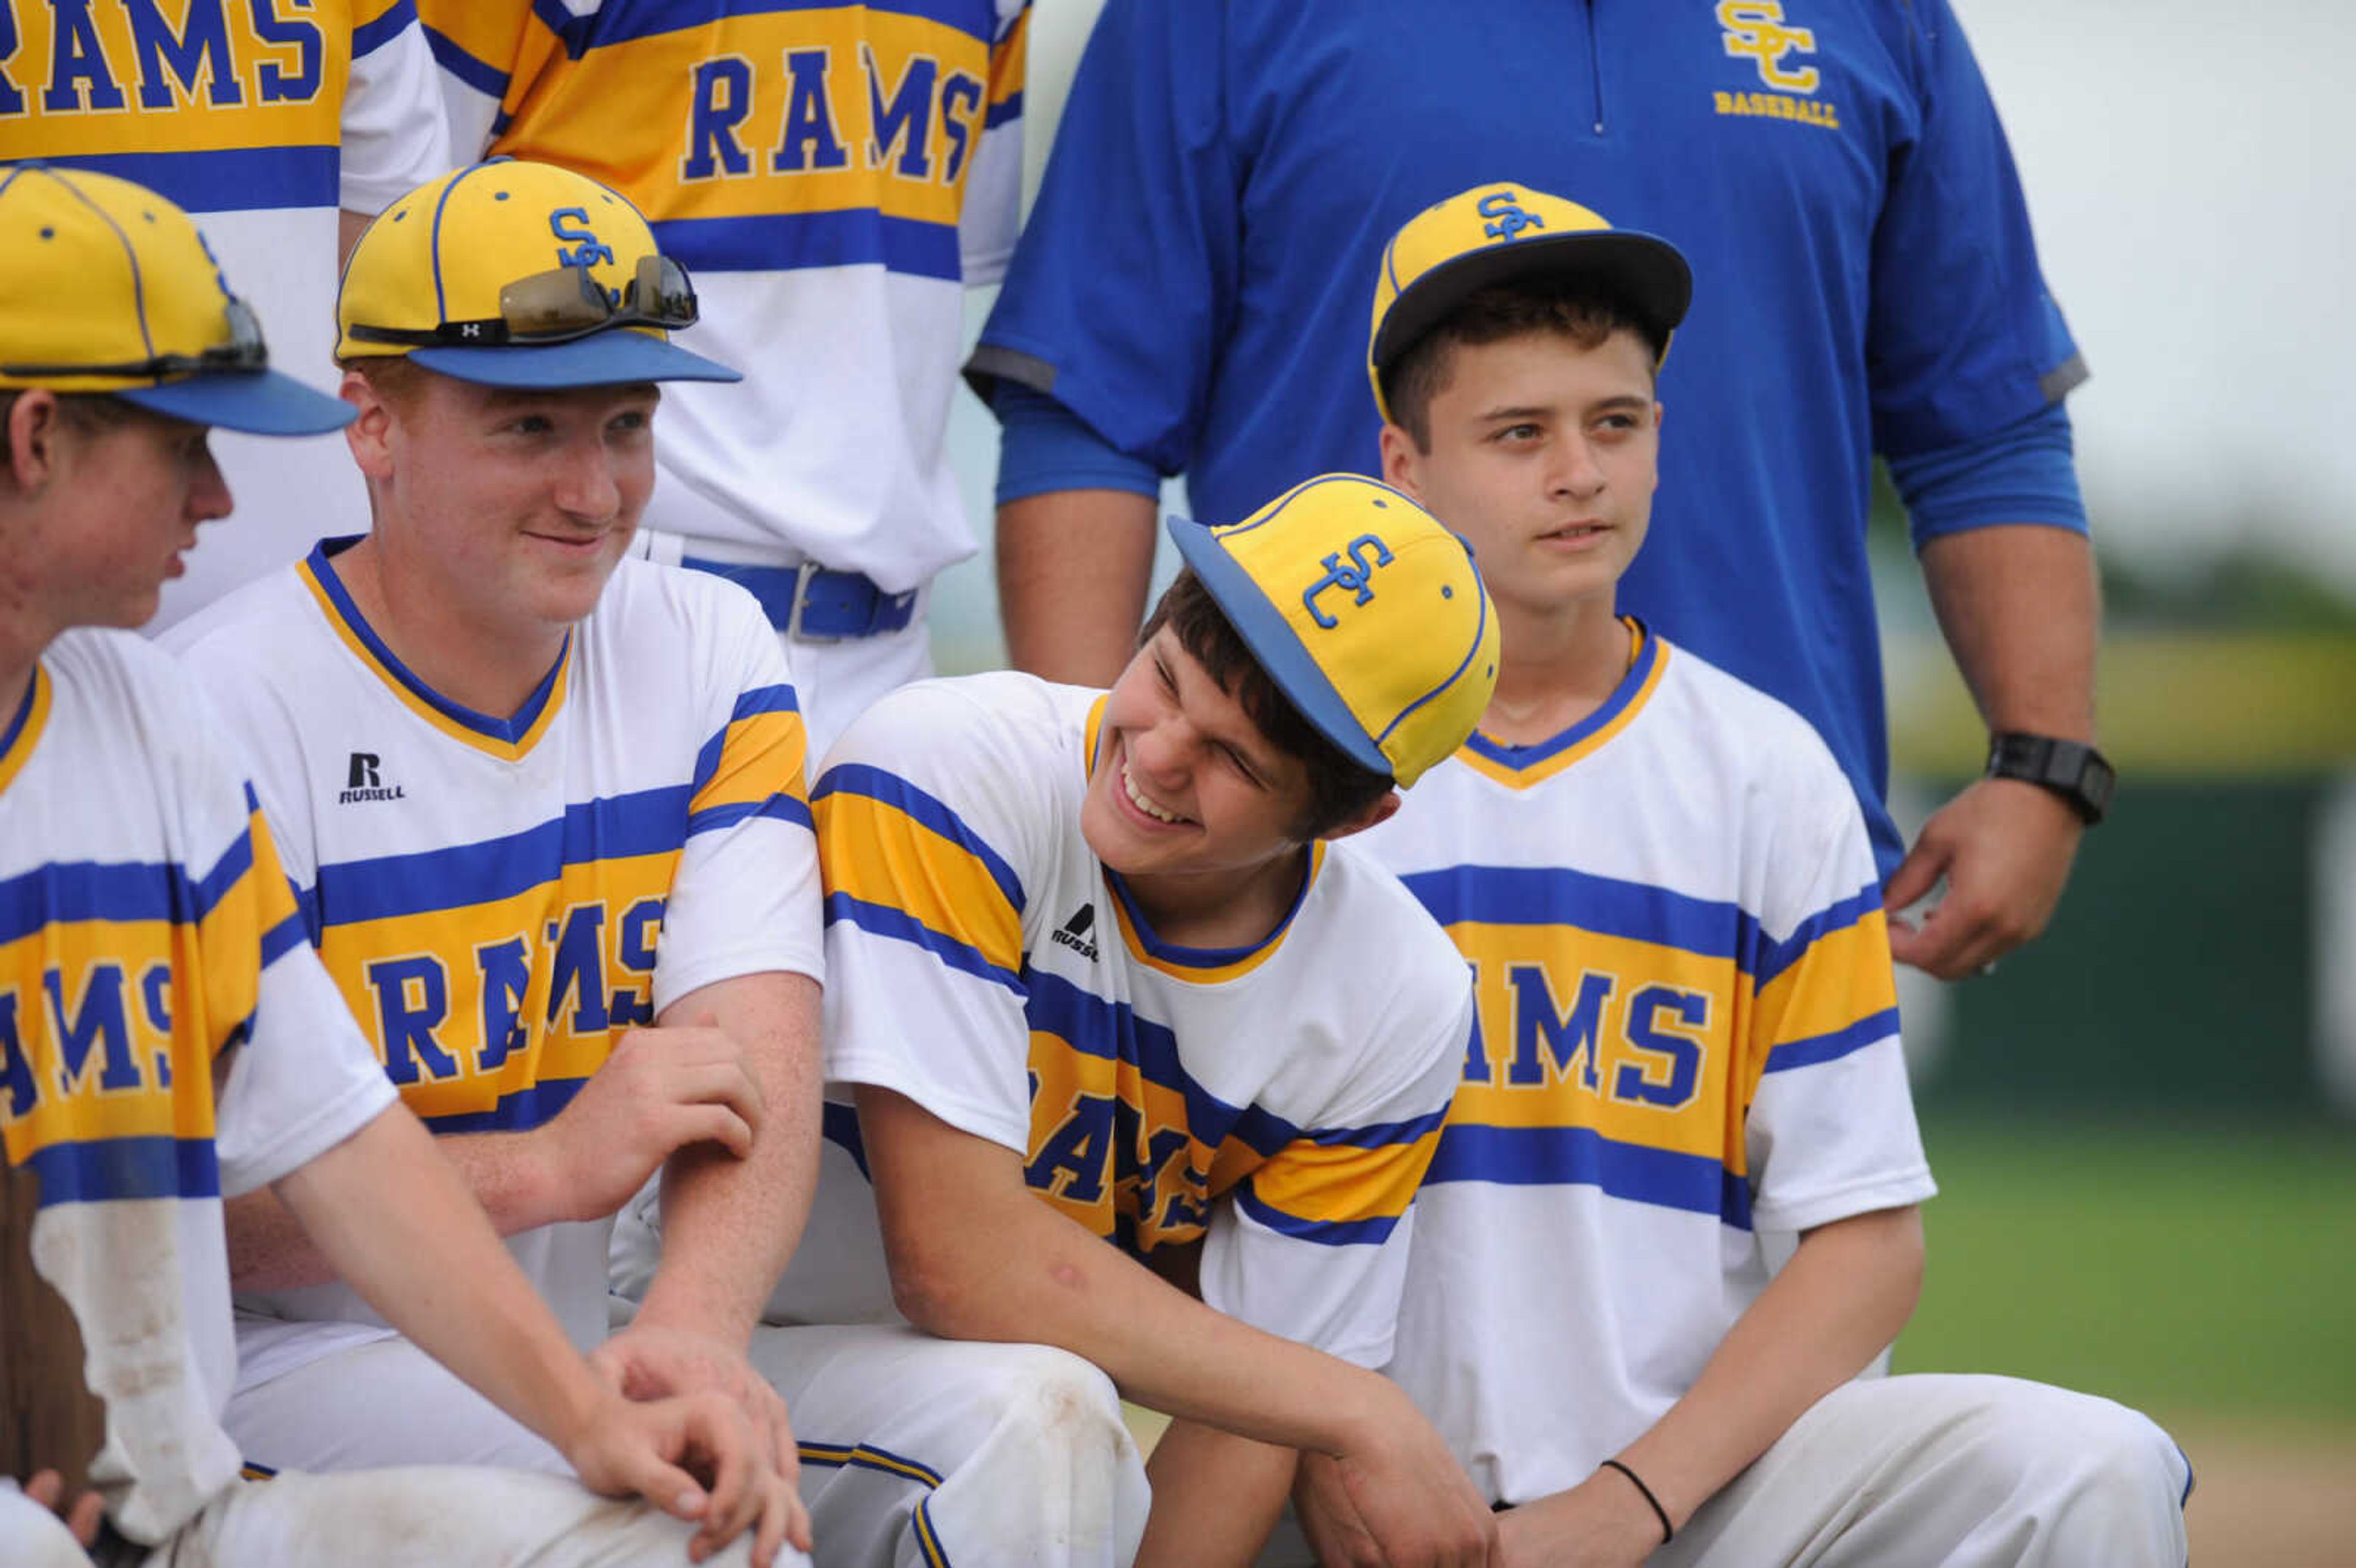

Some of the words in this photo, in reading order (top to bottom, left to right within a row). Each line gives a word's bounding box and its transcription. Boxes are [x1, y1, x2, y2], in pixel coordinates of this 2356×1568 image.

[1715, 0, 1820, 94] SC
[678, 40, 987, 186] RAMS
[1712, 91, 1839, 130] BASEBALL
[1303, 533, 1395, 629] SC
[339, 785, 406, 804] RUSSELL
